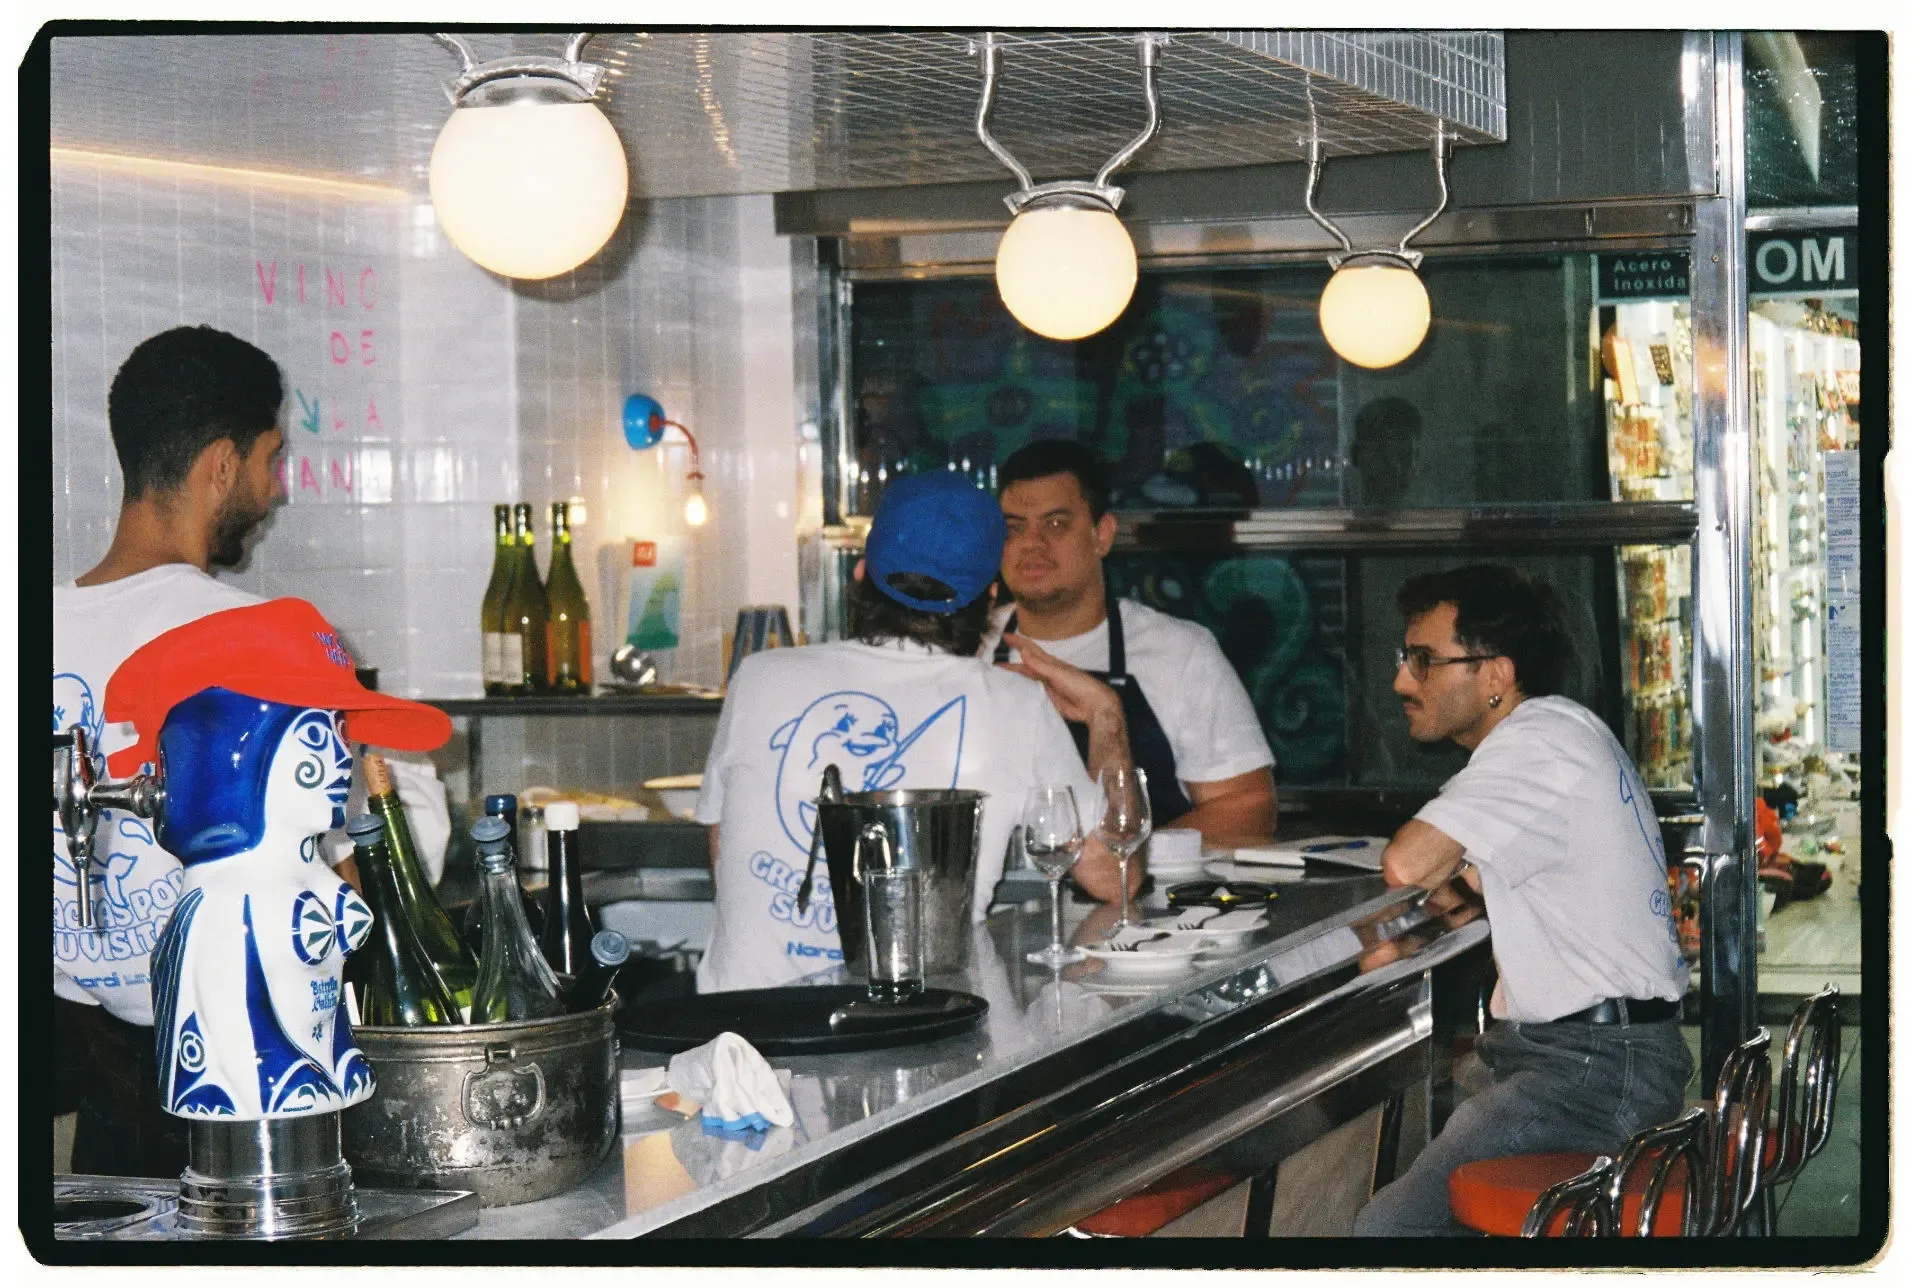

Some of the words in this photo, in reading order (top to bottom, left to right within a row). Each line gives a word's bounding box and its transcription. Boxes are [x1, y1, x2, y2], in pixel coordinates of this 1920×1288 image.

[1613, 259, 1672, 273] Acero
[1755, 237, 1847, 284] OM
[256, 260, 379, 311] VINO
[329, 329, 377, 365] DE
[332, 393, 384, 432] LA
